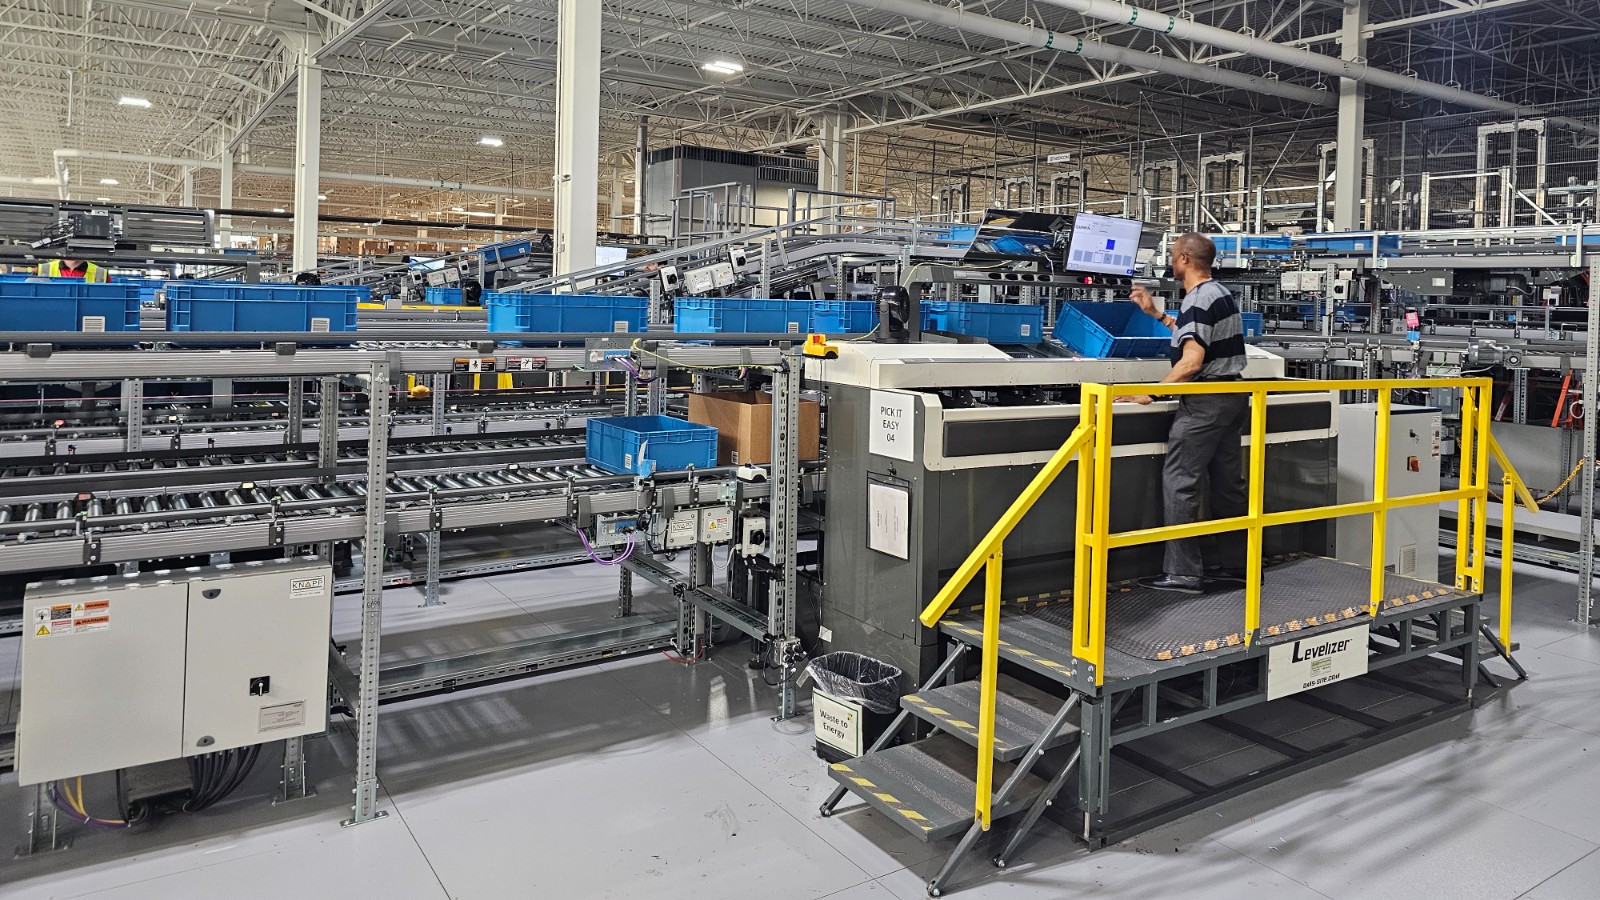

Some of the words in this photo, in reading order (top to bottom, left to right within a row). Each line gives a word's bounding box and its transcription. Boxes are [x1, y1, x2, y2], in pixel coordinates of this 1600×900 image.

[881, 406, 895, 417] PICK
[897, 409, 902, 418] IT
[883, 420, 899, 430] EASY
[887, 433, 894, 442] 04
[293, 579, 323, 588] KNAPP
[1292, 639, 1350, 663] Levelizer
[820, 709, 839, 724] Waste
[841, 720, 848, 728] to
[823, 722, 845, 739] Energy
